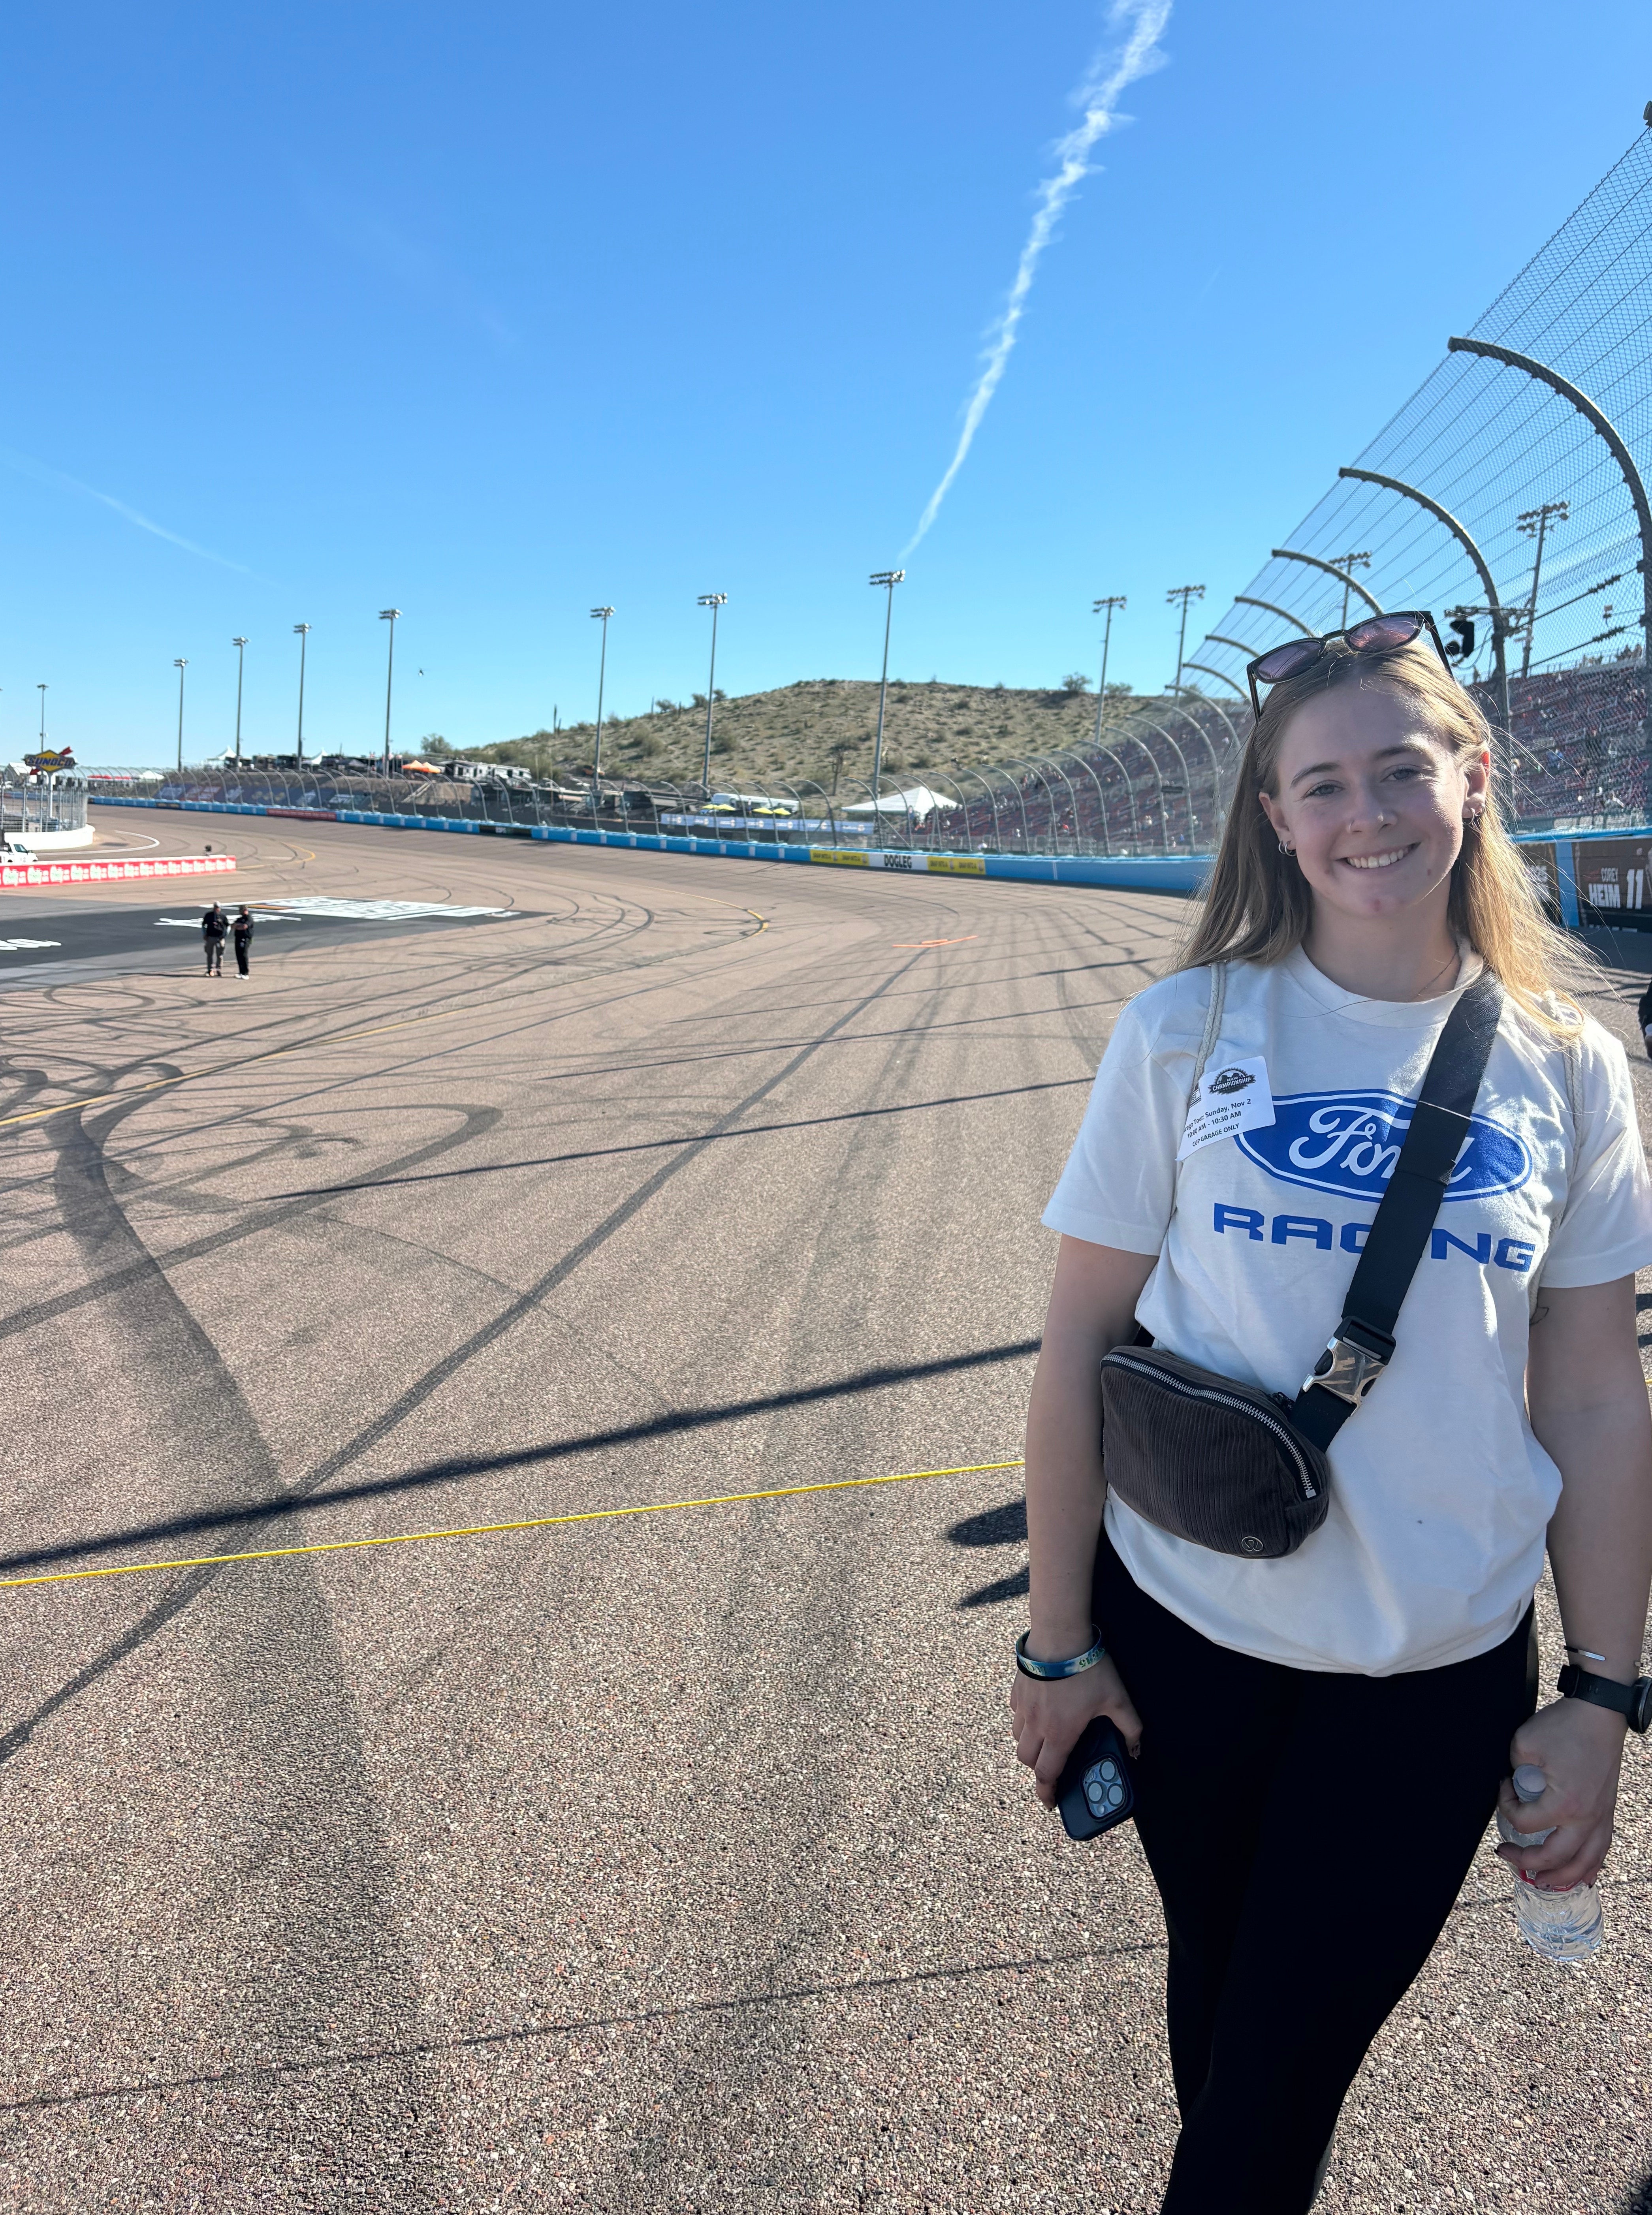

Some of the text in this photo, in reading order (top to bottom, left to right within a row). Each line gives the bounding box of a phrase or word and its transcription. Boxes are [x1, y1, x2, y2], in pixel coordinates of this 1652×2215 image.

[28, 757, 73, 767] SUNOCO
[884, 855, 912, 869] DOGLEG
[1601, 867, 1618, 882] COREY
[1588, 869, 1643, 910] HEIM 11
[1212, 1077, 1251, 1091] CHAMPIONSHIP
[1205, 1106, 1229, 1118] Sunday,
[1198, 1123, 1206, 1132] AM
[1211, 1115, 1228, 1125] 10:30
[1230, 1111, 1241, 1119] AM
[1201, 1129, 1222, 1141] GARAGE
[1223, 1123, 1239, 1132] ONLY
[1214, 1203, 1535, 1272] RACNG
